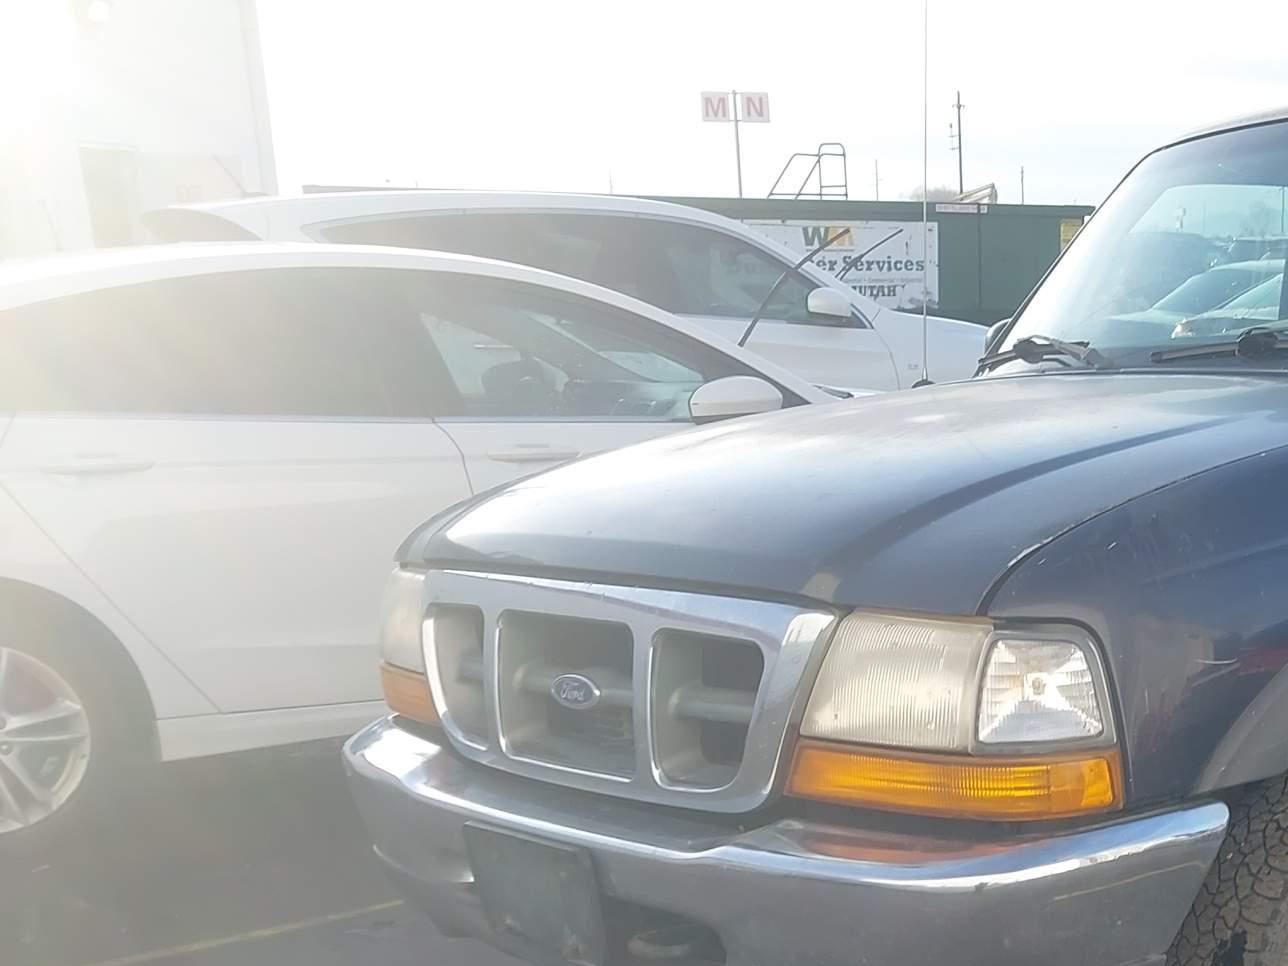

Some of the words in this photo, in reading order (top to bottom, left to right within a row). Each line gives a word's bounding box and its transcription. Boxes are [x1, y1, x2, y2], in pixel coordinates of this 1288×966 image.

[704, 96, 727, 118] M
[746, 95, 764, 118] N
[560, 680, 586, 701] Ford
